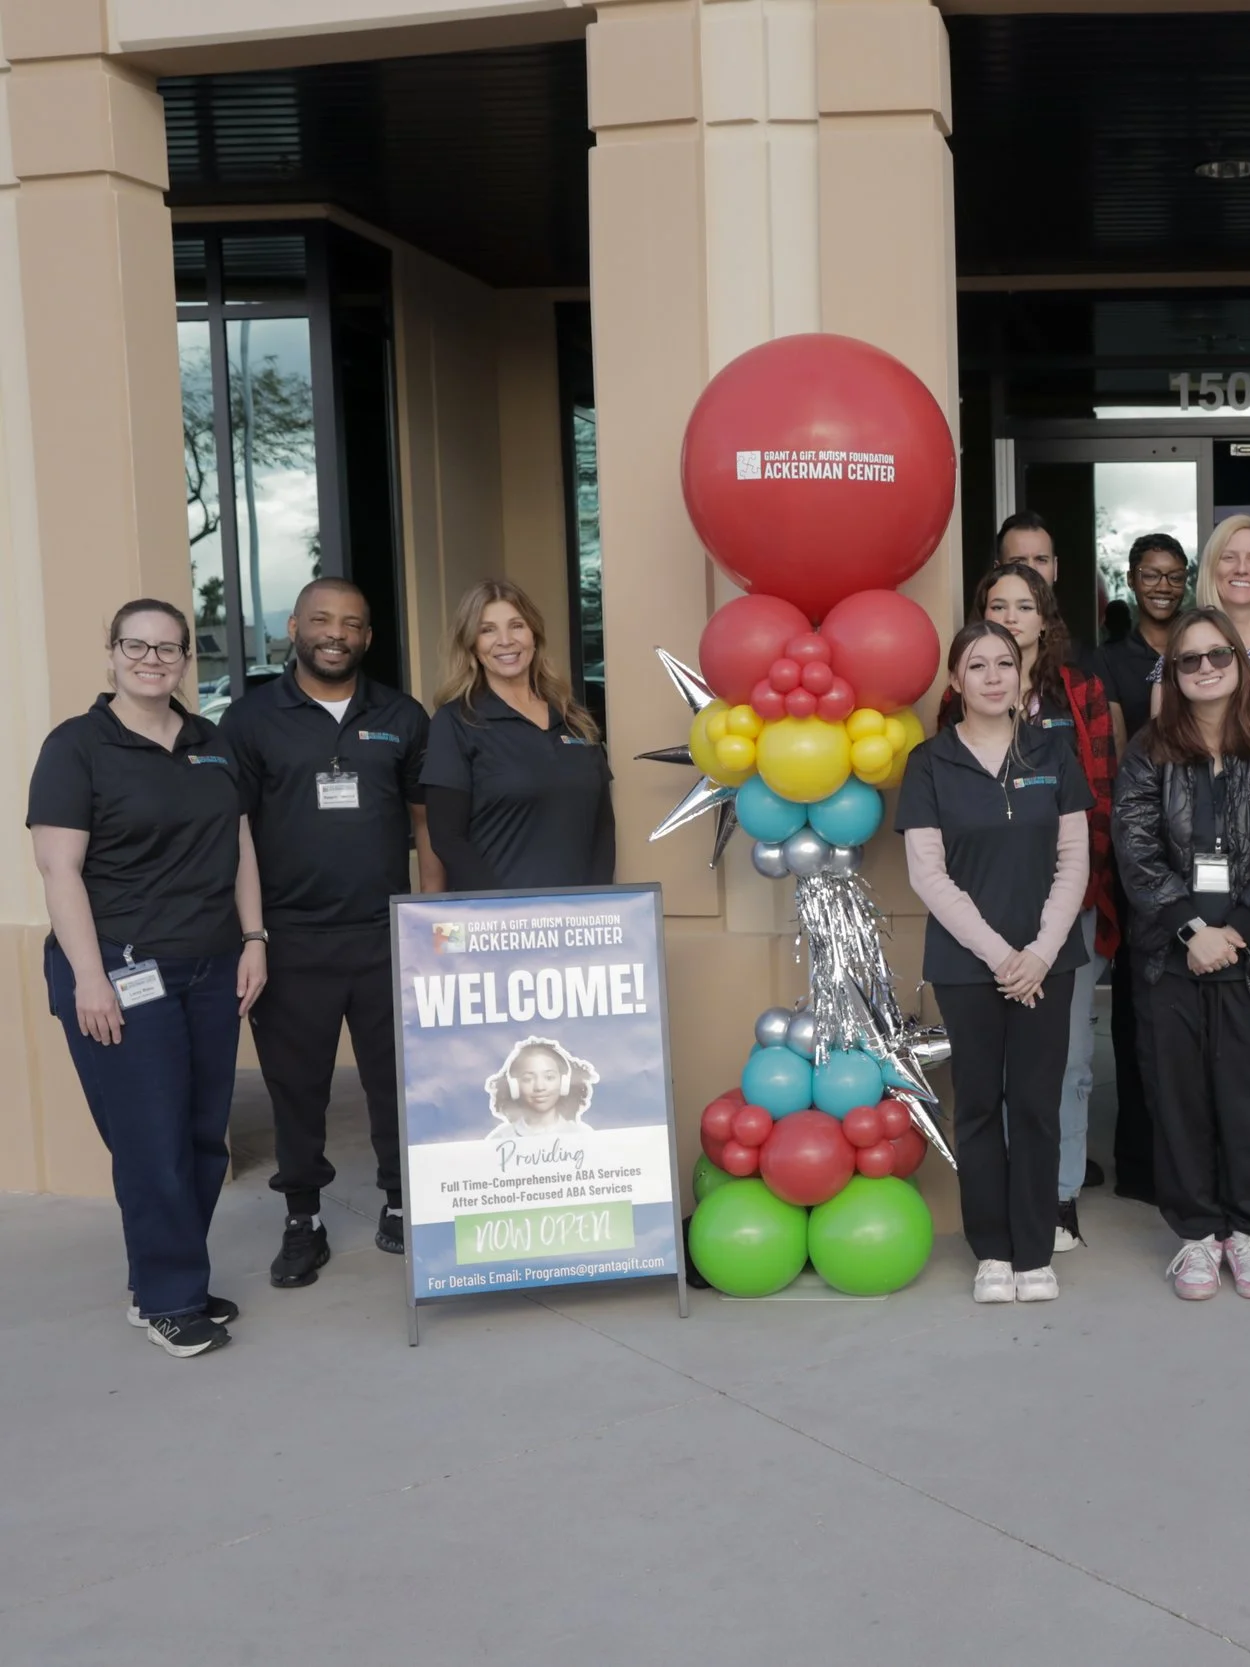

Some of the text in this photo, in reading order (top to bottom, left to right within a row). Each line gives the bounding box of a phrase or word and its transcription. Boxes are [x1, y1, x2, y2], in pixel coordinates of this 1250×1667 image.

[764, 451, 790, 461] GRANT
[791, 451, 798, 461] A
[818, 450, 847, 461] AUTISM
[849, 452, 895, 464] FOUNDATION
[764, 462, 895, 483] ACKERMAN CENTER
[468, 920, 498, 933] GRANT
[500, 920, 508, 931] A
[531, 917, 563, 929] AUTISM
[565, 914, 621, 928] FOUNDATION
[468, 926, 623, 953] ACKERMAN CENTER
[413, 963, 647, 1028] WELCOME!
[496, 1137, 585, 1173] Providing
[440, 1166, 642, 1193] Full Time-Comprehensive ABA Services
[452, 1183, 633, 1208] After School-Focused ABA Services
[475, 1210, 613, 1253] NOW OPEN
[428, 1257, 665, 1290] For Details Email: Programs@grantagift.com
